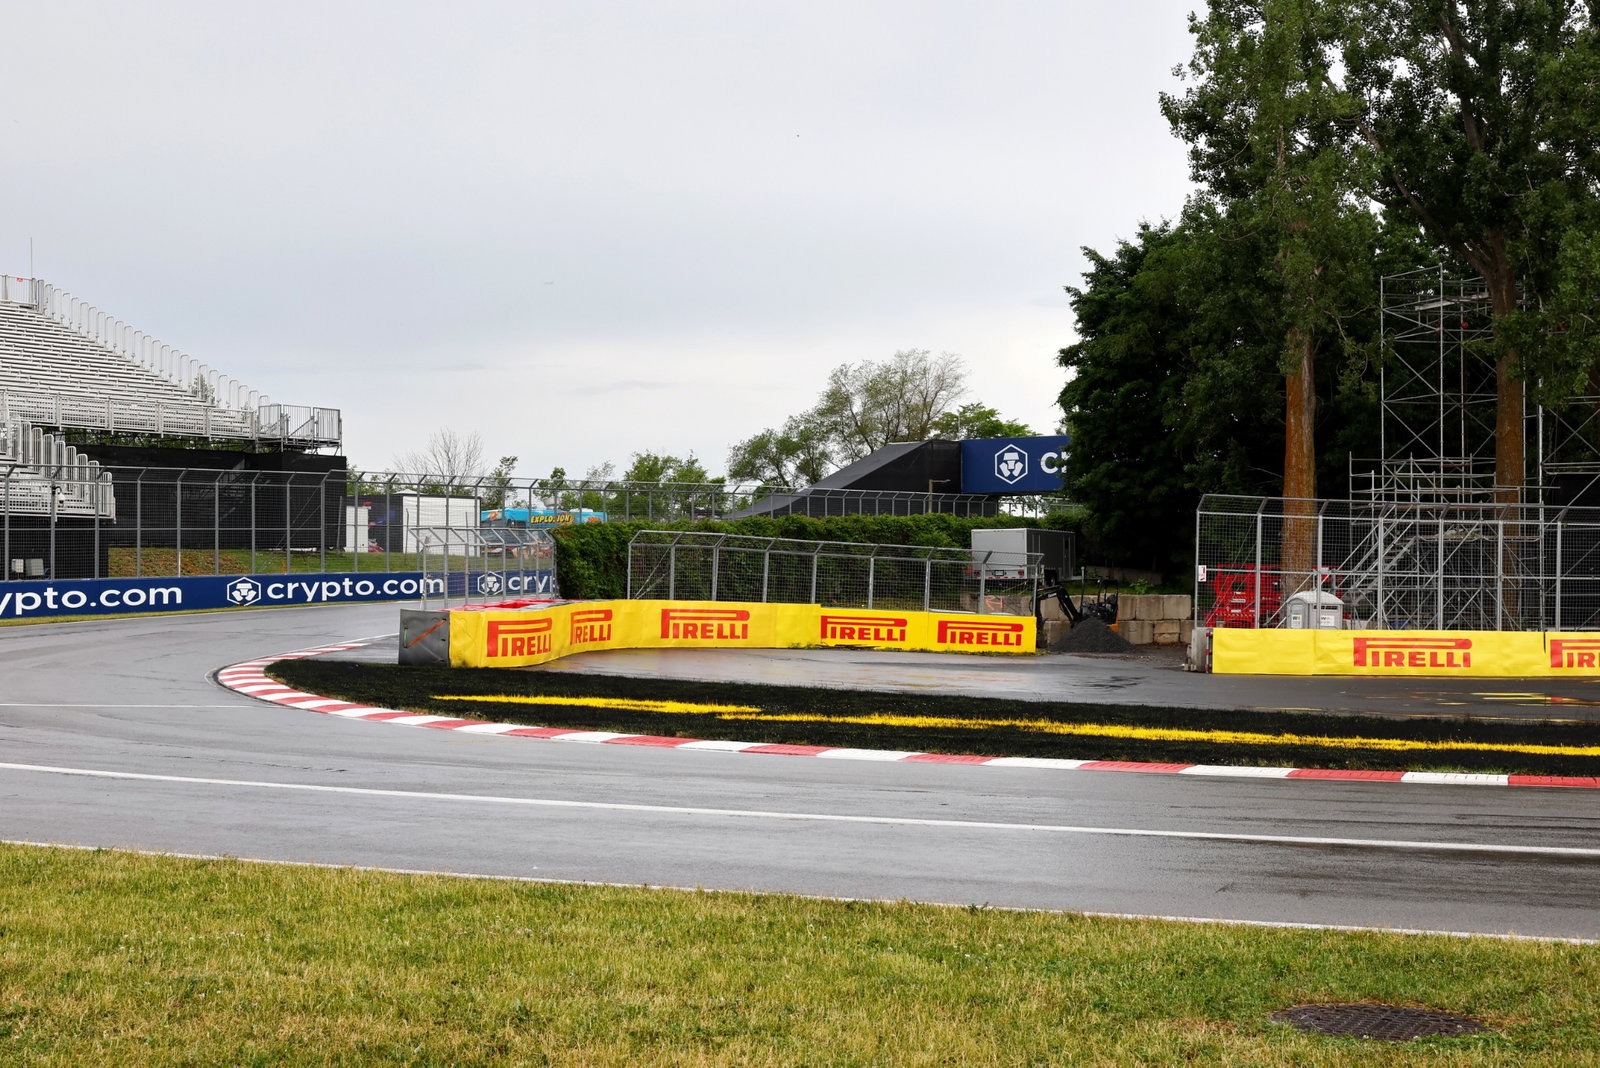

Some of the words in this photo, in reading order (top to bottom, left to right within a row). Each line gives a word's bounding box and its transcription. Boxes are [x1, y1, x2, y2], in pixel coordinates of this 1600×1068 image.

[530, 514, 570, 523] EXPLOION
[267, 578, 443, 602] crypto.com
[487, 618, 552, 657] PIRELLI
[661, 609, 750, 640] PIRELLI
[821, 615, 907, 642] PIRELLI
[937, 620, 1024, 646] PIRELLI
[1353, 637, 1473, 668] PIRELLI
[1550, 639, 1600, 668] PIR
